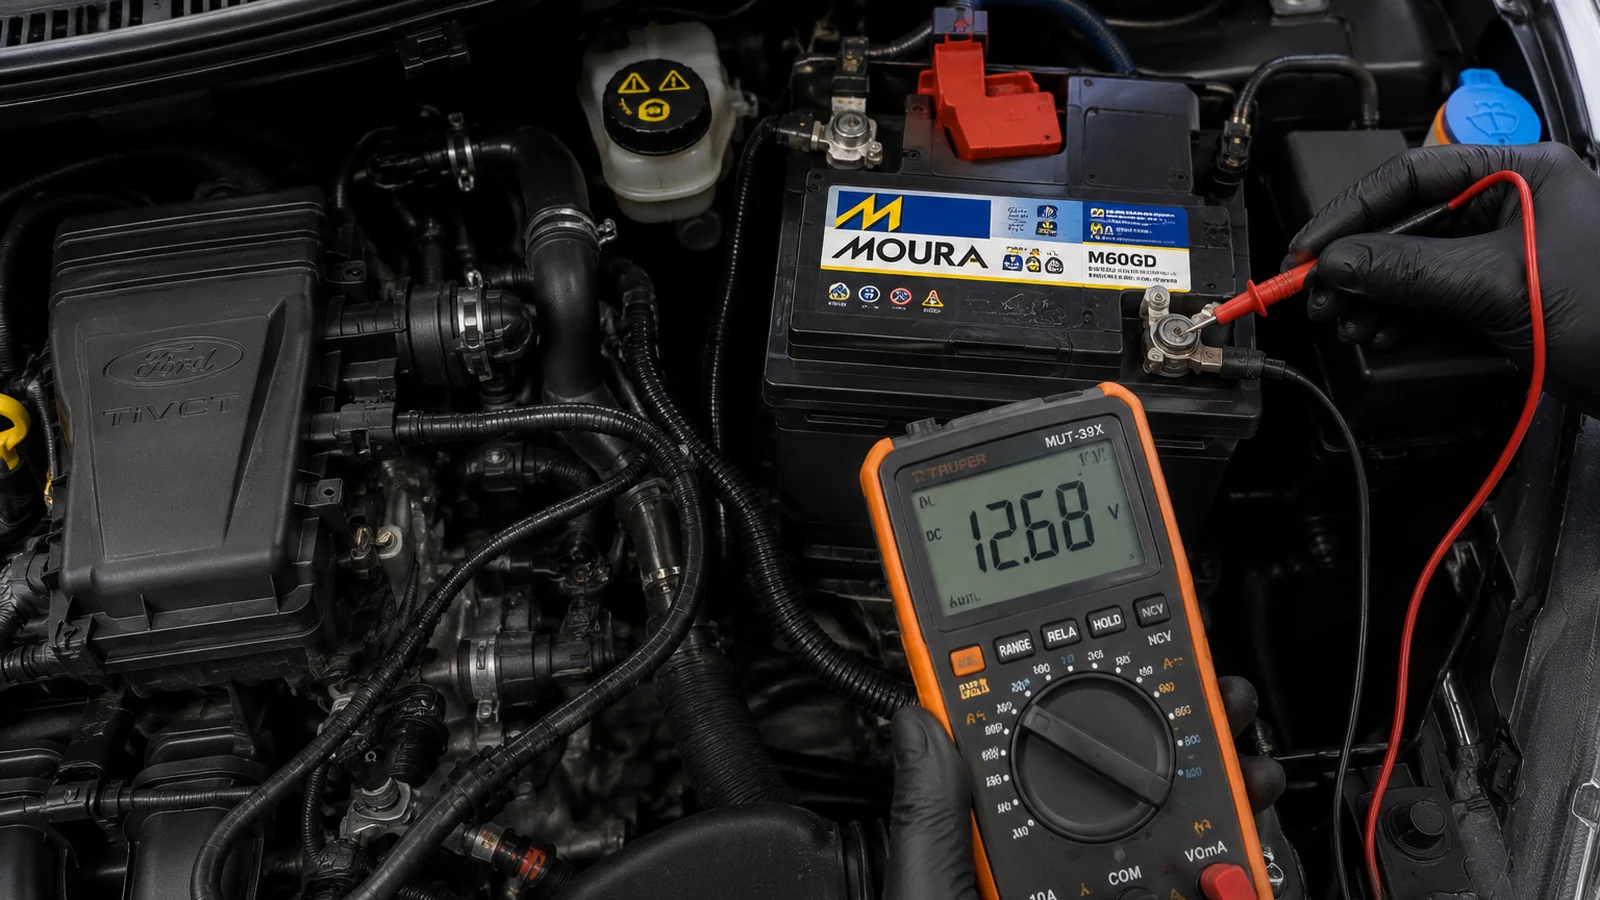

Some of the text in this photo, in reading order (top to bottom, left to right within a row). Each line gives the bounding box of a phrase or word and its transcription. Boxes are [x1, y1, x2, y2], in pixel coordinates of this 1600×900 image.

[832, 235, 989, 269] MOURA
[1087, 250, 1157, 268] M60GD
[134, 345, 217, 380] Ford
[1044, 423, 1105, 448] MUT-39X
[1106, 502, 1120, 520] V
[926, 527, 942, 542] DC
[969, 480, 1095, 573] 12.68
[1141, 603, 1164, 619] NCV
[1092, 613, 1122, 631] HOLD
[1047, 626, 1077, 643] RELA
[1147, 630, 1172, 646] NCV
[998, 638, 1033, 657] RANGE
[1107, 865, 1143, 886] COM
